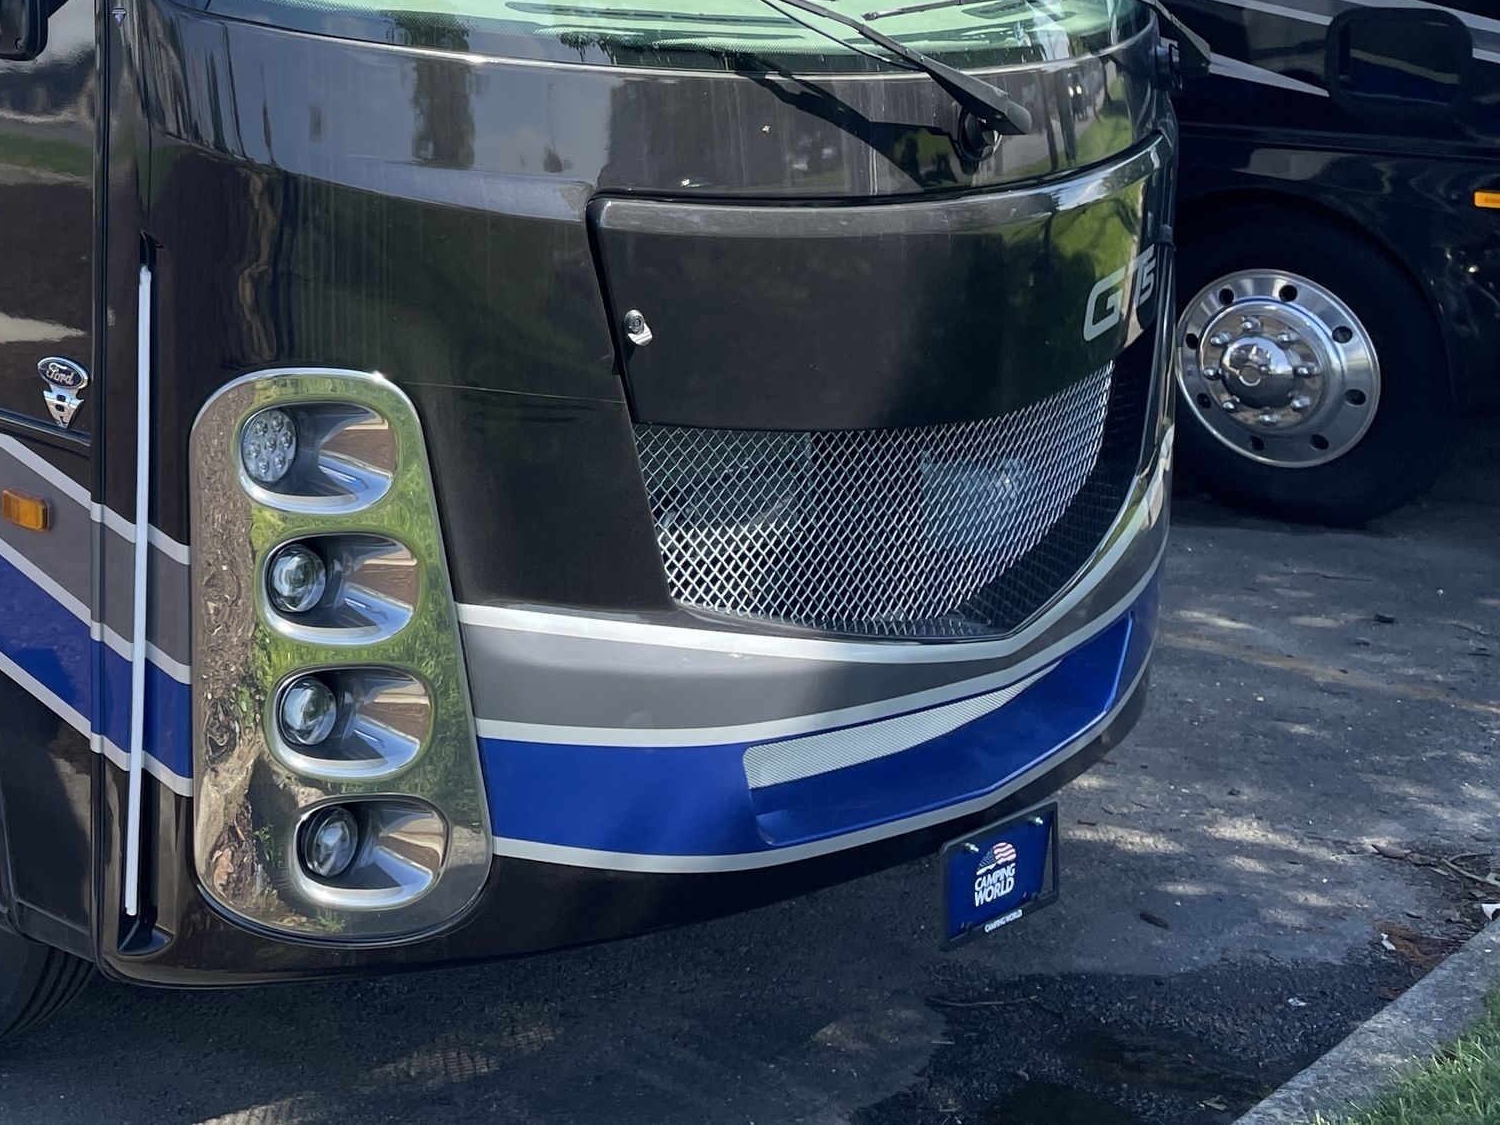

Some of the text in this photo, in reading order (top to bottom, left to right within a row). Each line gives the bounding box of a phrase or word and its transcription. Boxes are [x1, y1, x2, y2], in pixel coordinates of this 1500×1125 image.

[46, 362, 75, 386] Ford
[974, 862, 1016, 892] CAMPING
[974, 877, 1015, 907] WORLD
